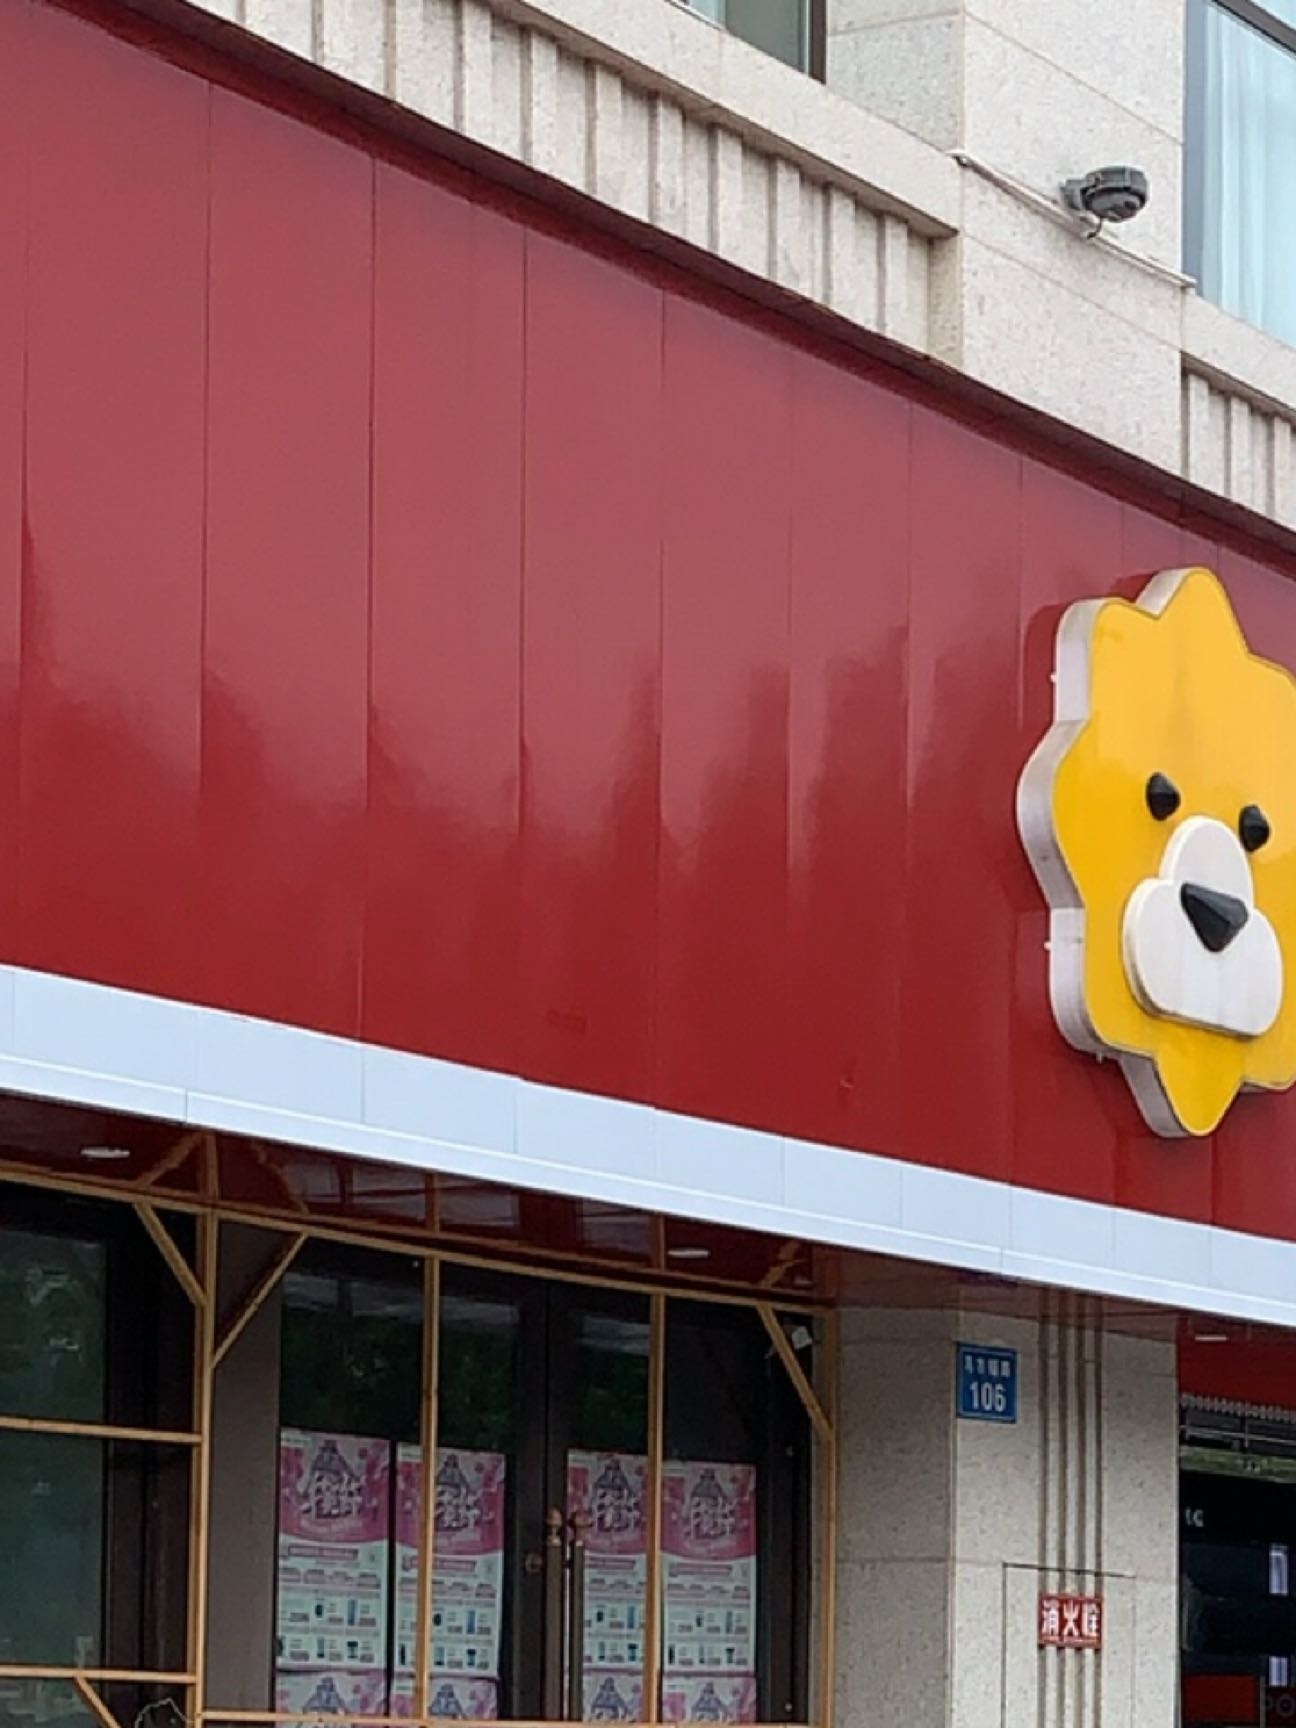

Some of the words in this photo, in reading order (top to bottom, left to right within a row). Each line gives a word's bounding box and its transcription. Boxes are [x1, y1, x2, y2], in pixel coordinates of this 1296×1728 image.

[969, 1381, 1007, 1412] 106
[1041, 1599, 1100, 1637] 消火栓
